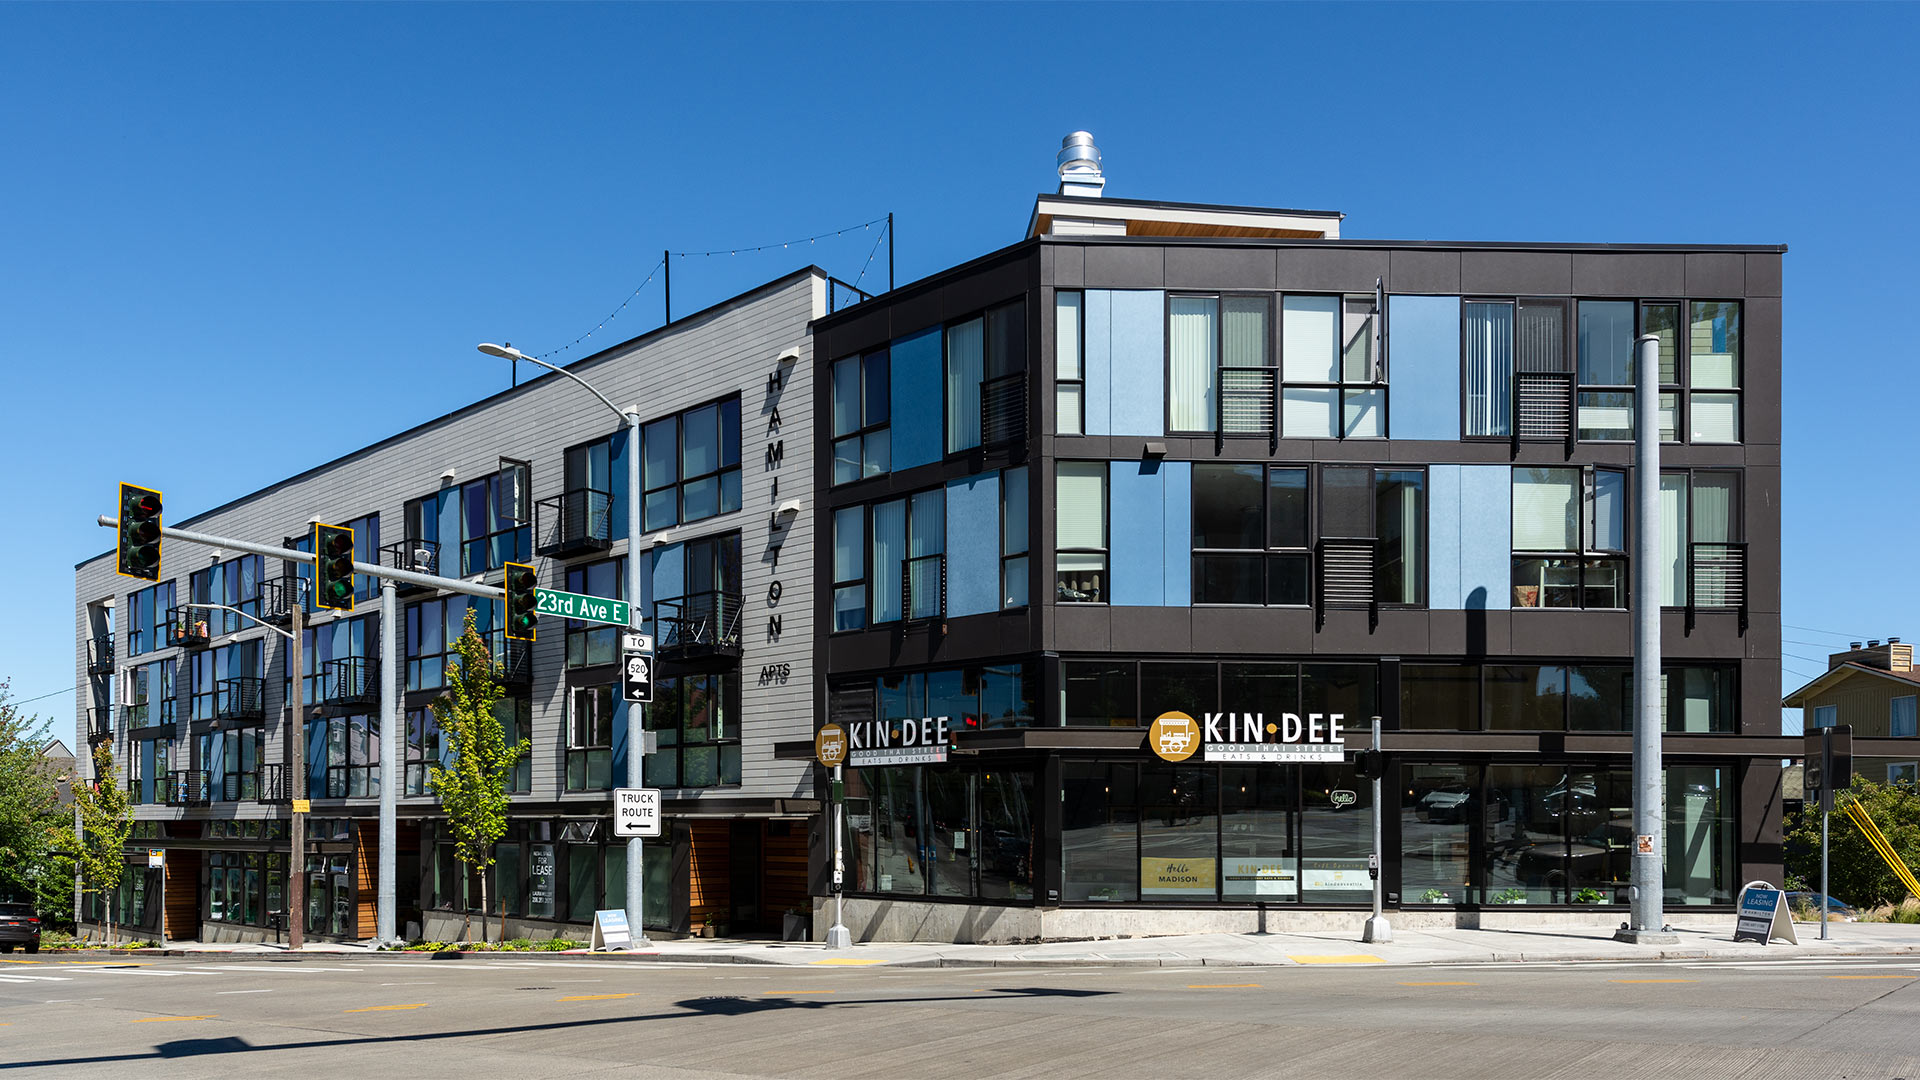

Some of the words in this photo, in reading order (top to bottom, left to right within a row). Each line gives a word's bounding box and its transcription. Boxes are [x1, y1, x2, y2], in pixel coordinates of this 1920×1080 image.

[768, 370, 784, 636] HAMILTON
[537, 591, 573, 615] 23rd
[579, 599, 607, 619] Ave
[613, 604, 622, 622] E
[631, 638, 645, 648] TO
[630, 664, 646, 674] 520
[760, 663, 790, 679] APTS
[912, 746, 946, 754] STREET
[622, 794, 654, 803] TRUCK
[622, 808, 653, 817] ROUTE
[532, 865, 553, 875] LEASE
[1166, 864, 1190, 873] Hello
